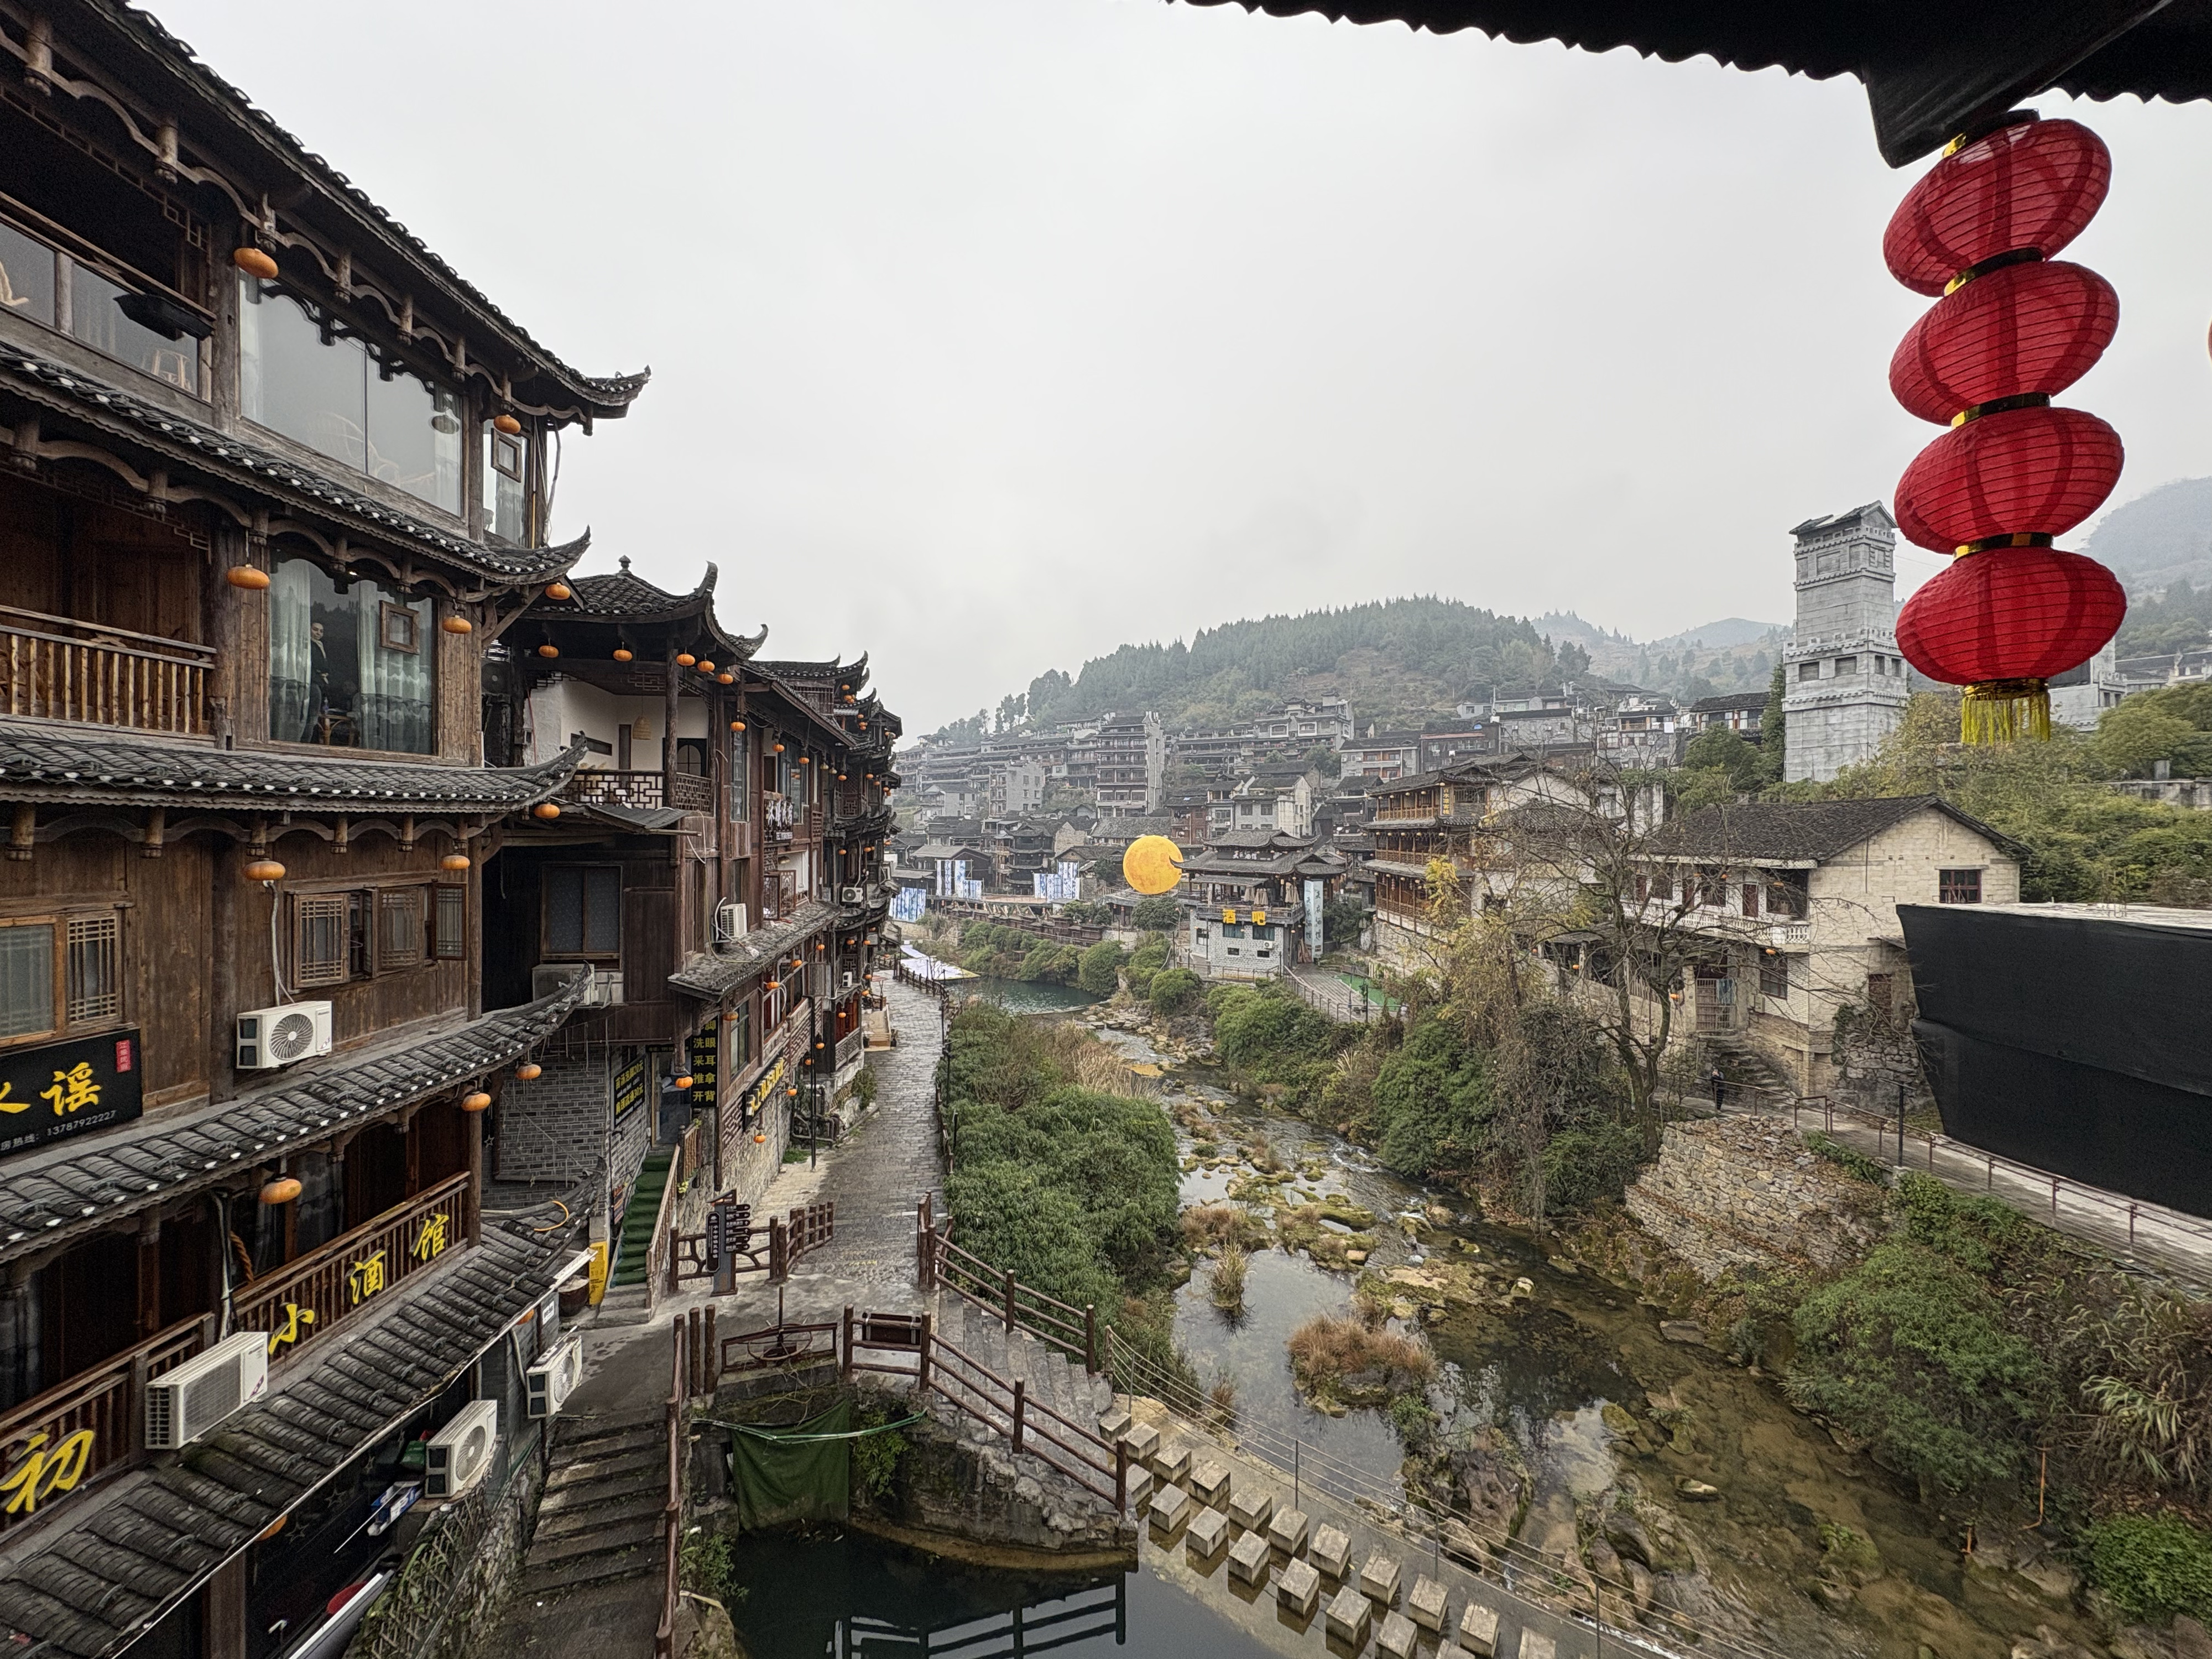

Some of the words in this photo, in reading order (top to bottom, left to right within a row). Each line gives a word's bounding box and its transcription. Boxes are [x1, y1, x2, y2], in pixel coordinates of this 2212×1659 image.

[1222, 909, 1266, 926] 酒吧
[705, 1020, 716, 1031] 脚
[693, 1037, 716, 1048] 洗眼
[693, 1055, 716, 1066] 采耳
[693, 1072, 716, 1084] 推拿
[692, 1090, 716, 1102] 开背
[46, 1109, 116, 1136] 13787922227
[0, 1430, 95, 1514] 初
[268, 1214, 449, 1355] 小酒馆
